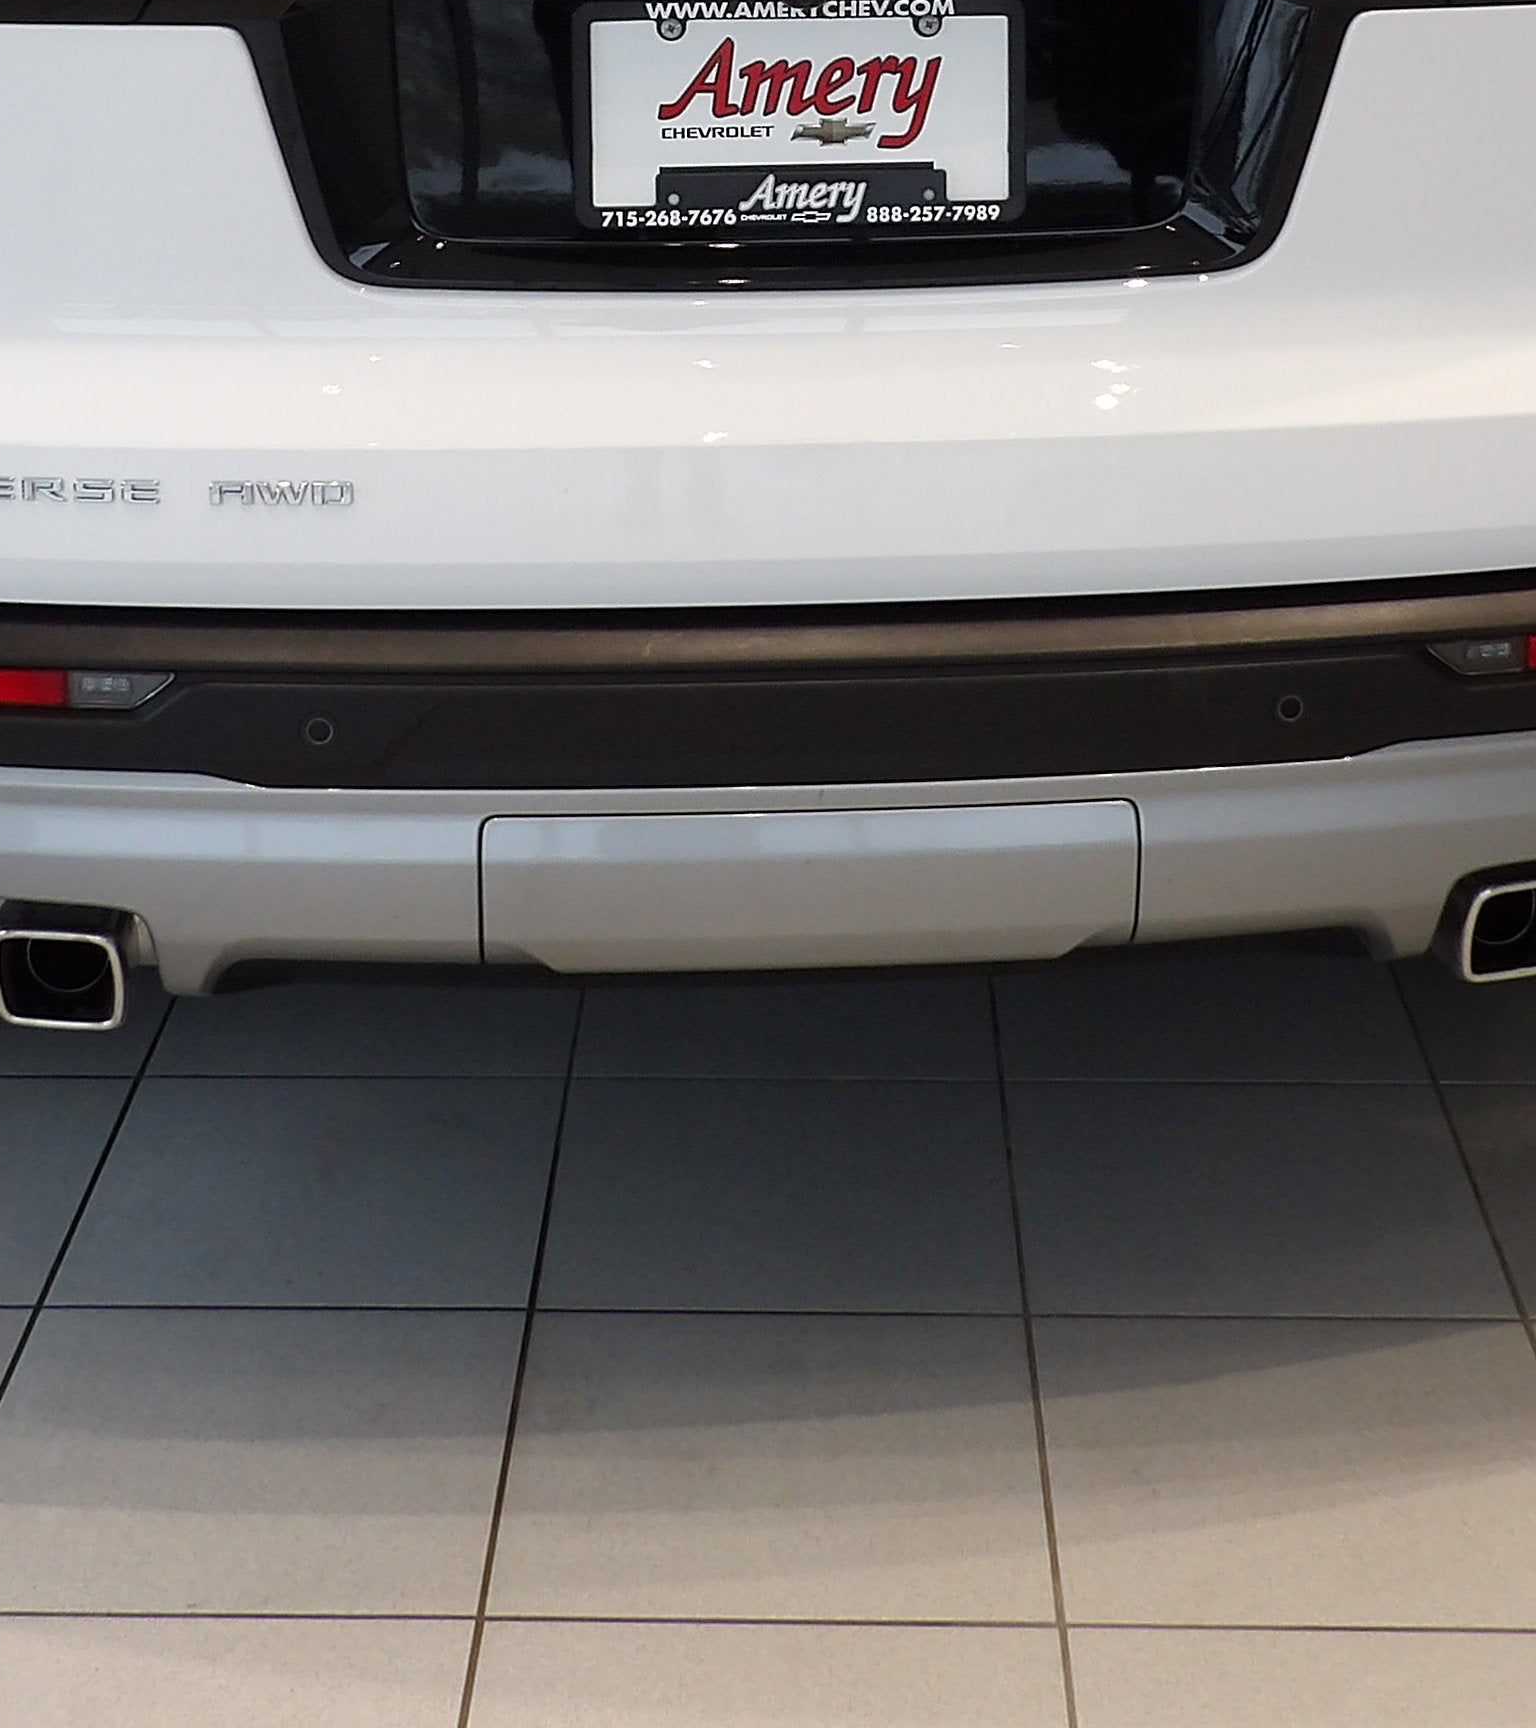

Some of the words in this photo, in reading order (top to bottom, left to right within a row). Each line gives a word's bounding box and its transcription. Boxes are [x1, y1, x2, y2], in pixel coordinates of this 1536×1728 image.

[658, 37, 942, 148] Amery
[661, 125, 774, 139] CHEVROLET
[738, 173, 867, 223] Amery
[601, 208, 737, 227] 715-268-7676
[866, 204, 1001, 223] 888-257-7989
[208, 480, 354, 506] AWD
